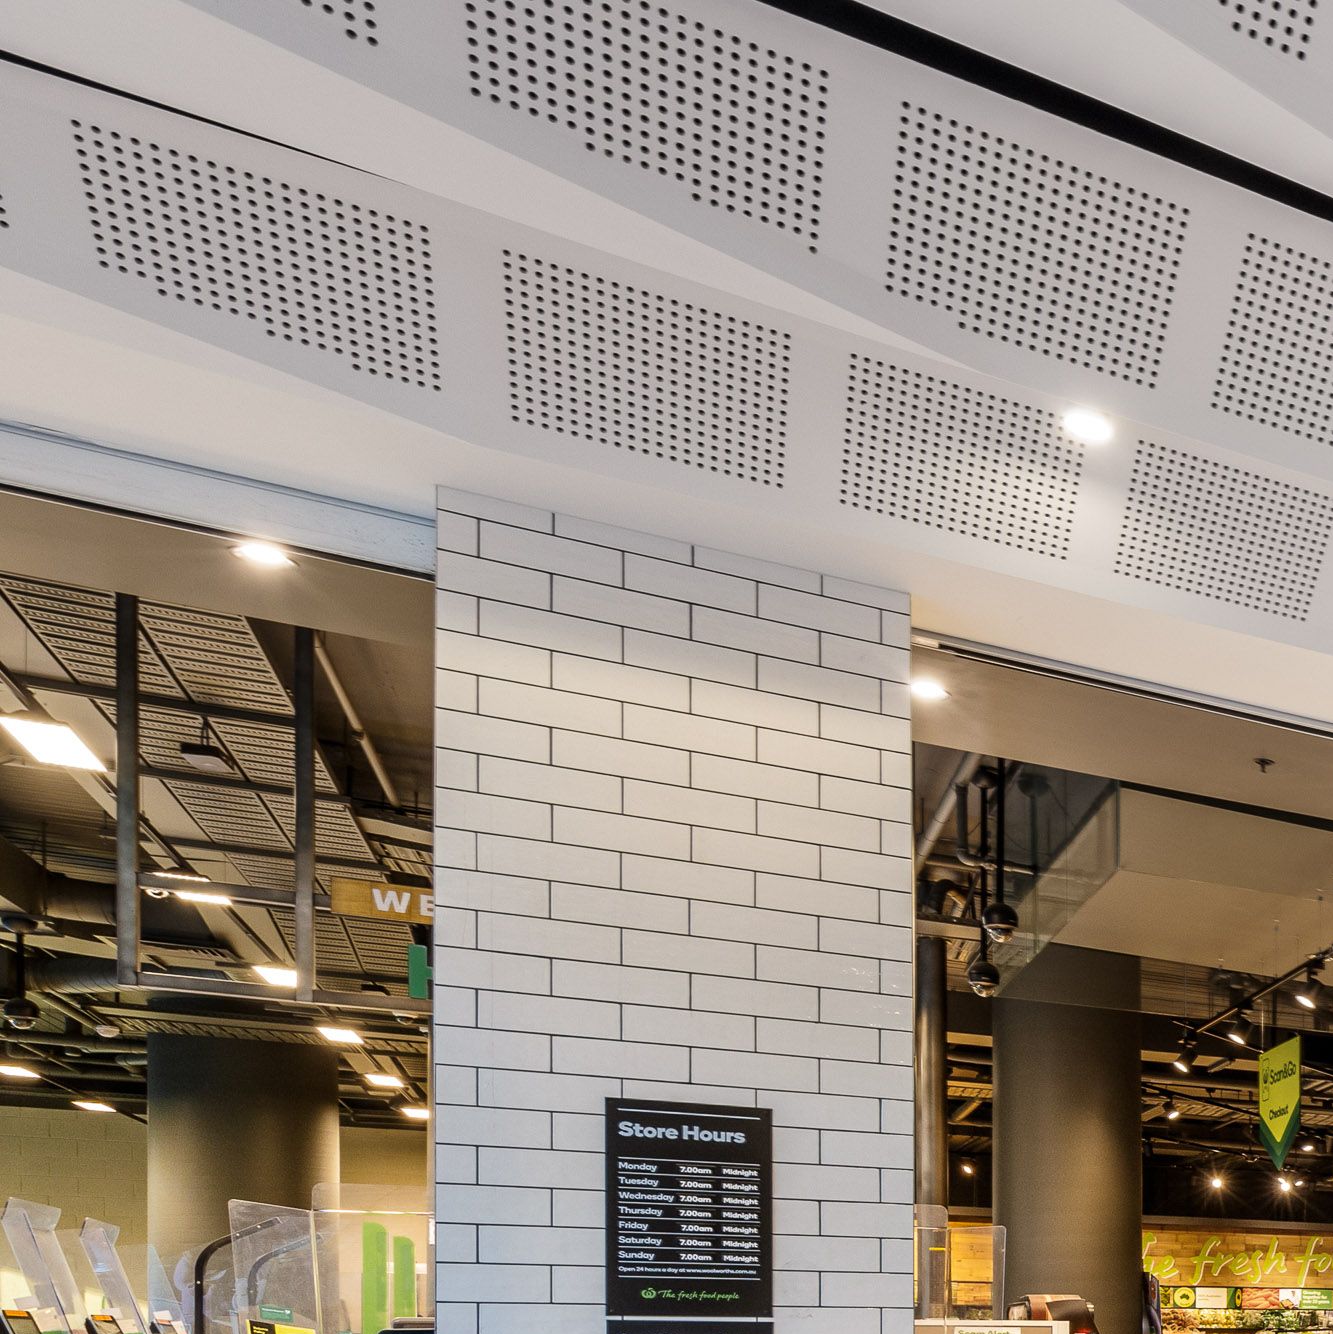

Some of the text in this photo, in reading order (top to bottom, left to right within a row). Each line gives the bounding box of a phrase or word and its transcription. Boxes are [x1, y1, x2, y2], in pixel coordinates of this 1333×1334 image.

[1269, 1060, 1296, 1085] Scan&Go
[1269, 1105, 1288, 1120] Checkout
[618, 1121, 746, 1144] Store Hours
[619, 1161, 758, 1177] Monday 7.00am Midnight
[619, 1176, 758, 1192] Tuesday 7.00am Midnight
[619, 1192, 758, 1206] Wednesday 7.00am Midnight
[619, 1206, 758, 1220] Thursday 7.00am Midnight
[619, 1221, 758, 1235] Friday 7.00am Midnight
[619, 1236, 758, 1249] Saturday 7.00am Midnight
[619, 1250, 758, 1263] Sunday 7.00am Midnight
[1142, 1232, 1180, 1279] he
[1189, 1236, 1288, 1286] fresh
[658, 1289, 740, 1301] The fresh food people
